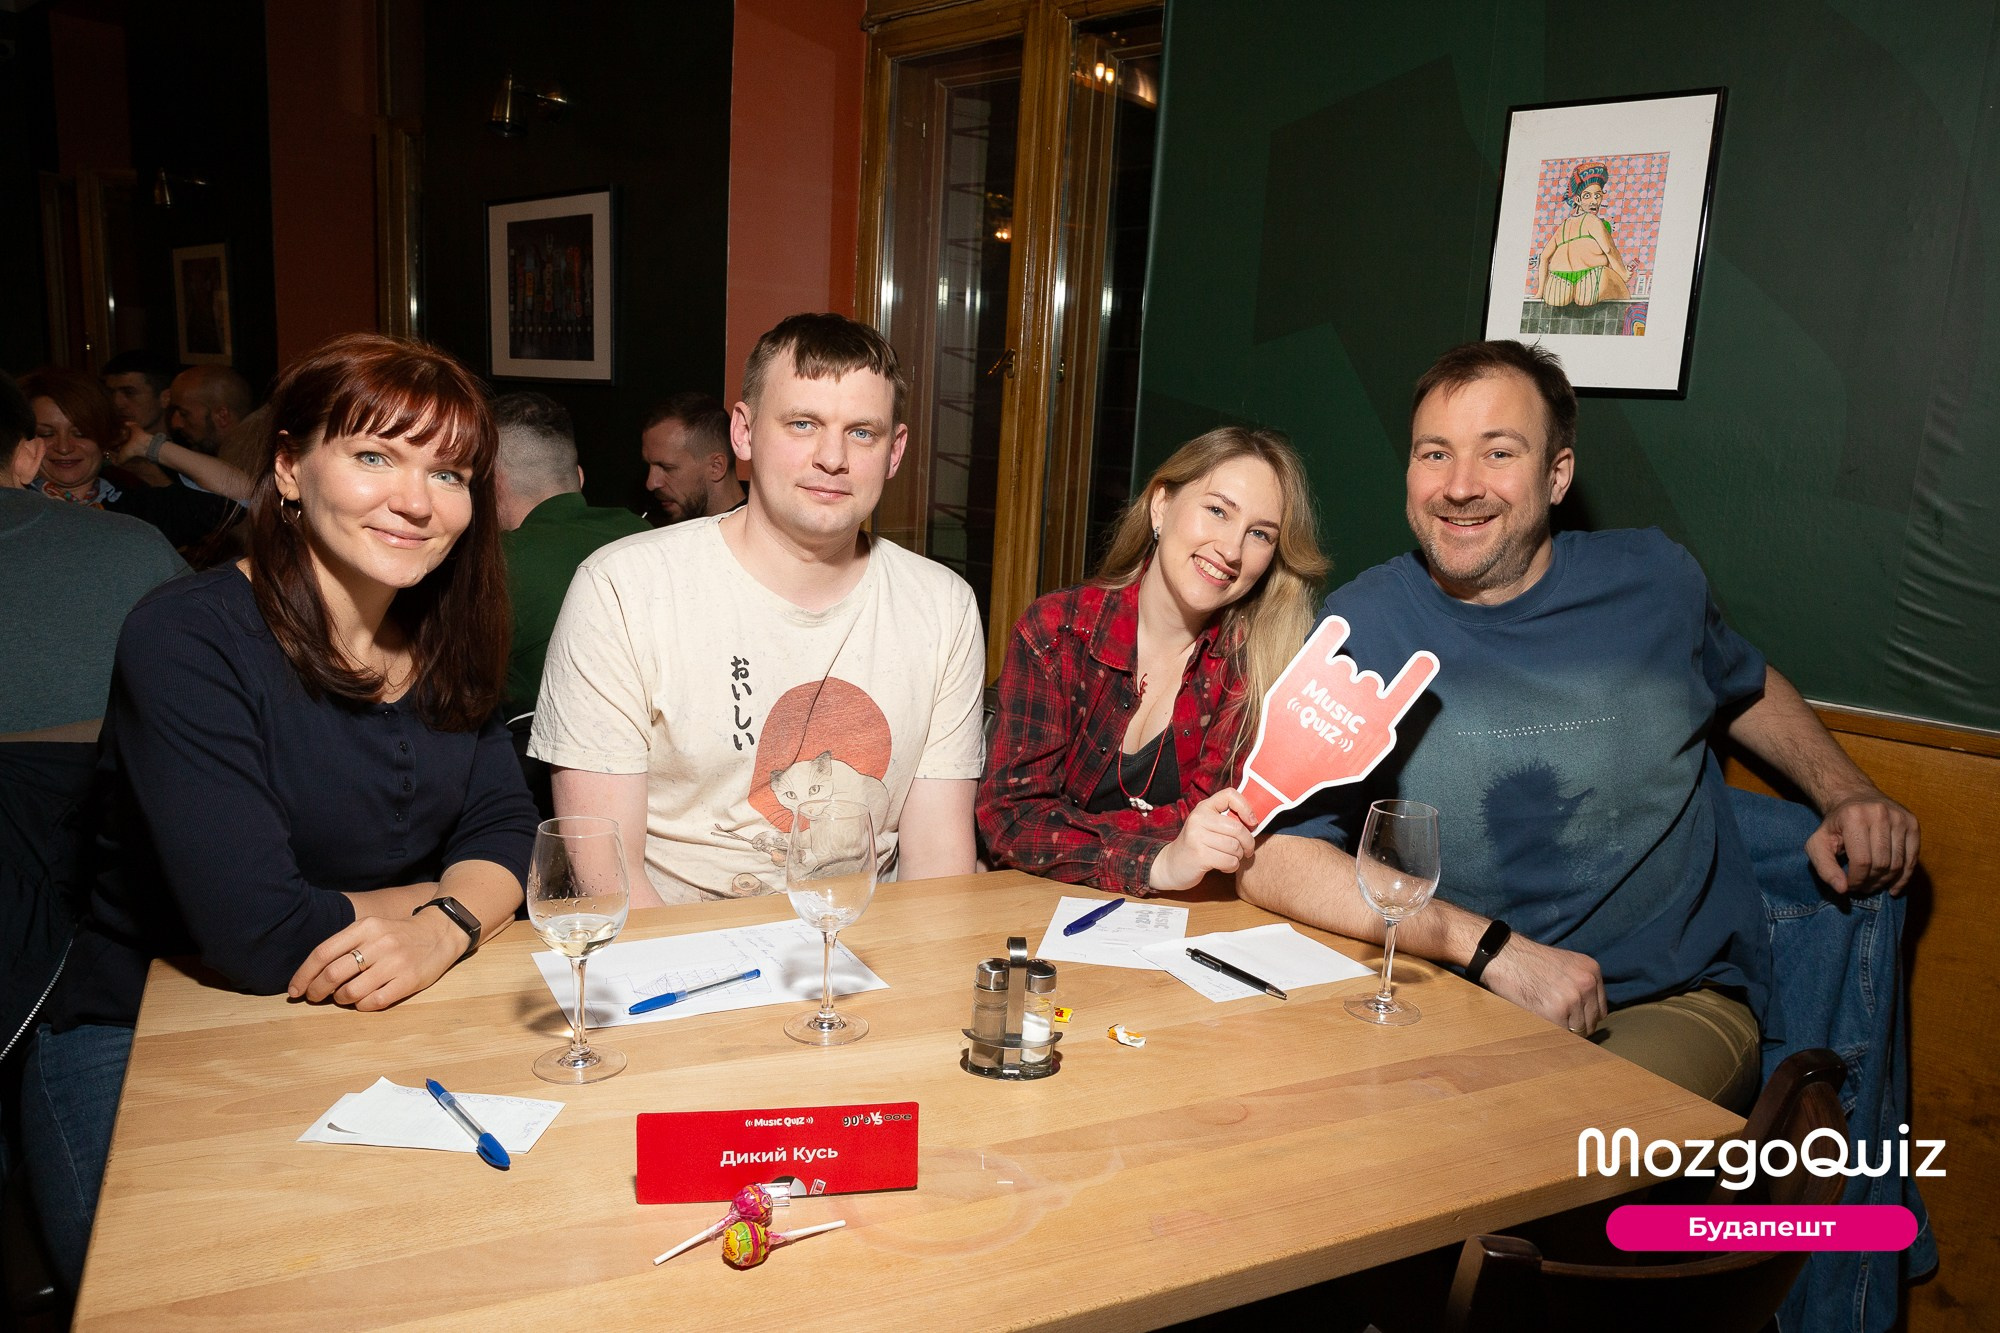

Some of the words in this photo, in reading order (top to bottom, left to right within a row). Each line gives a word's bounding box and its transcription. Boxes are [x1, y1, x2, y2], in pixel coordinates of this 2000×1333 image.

[730, 655, 755, 751] おいしい
[720, 1147, 787, 1167] Дикий
[793, 1146, 839, 1164] Кусь
